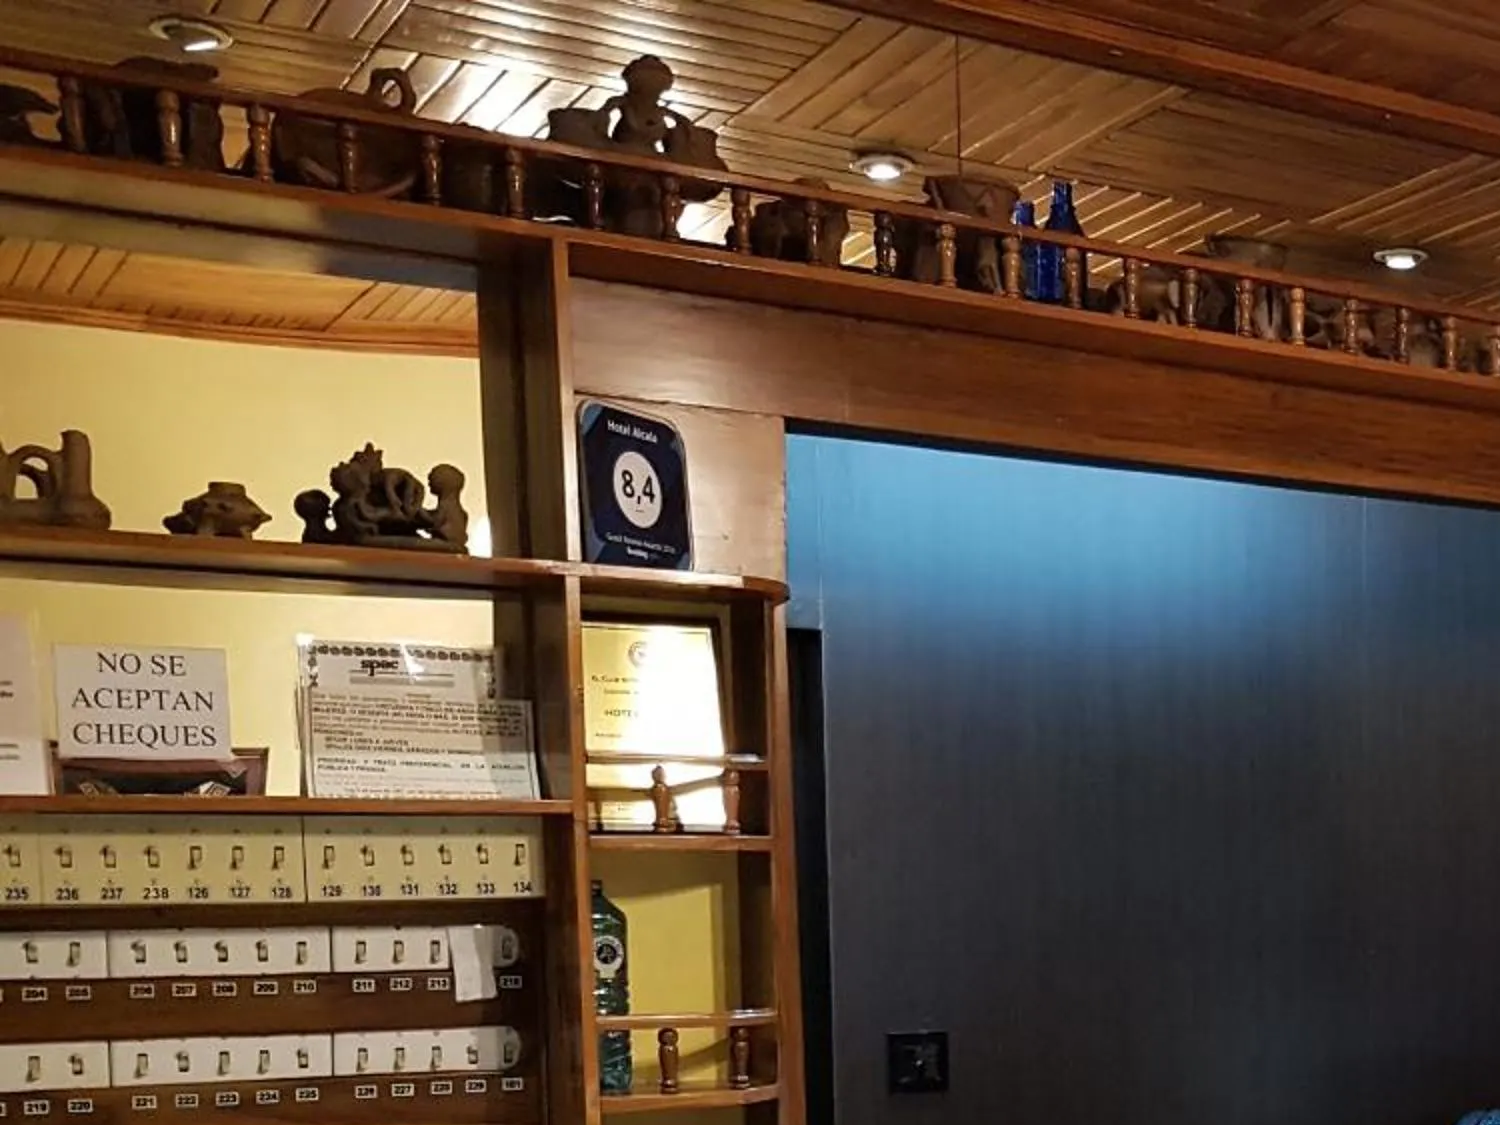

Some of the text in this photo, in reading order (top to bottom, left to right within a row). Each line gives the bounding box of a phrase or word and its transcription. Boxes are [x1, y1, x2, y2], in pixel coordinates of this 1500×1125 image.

[607, 419, 631, 437] Hotel
[621, 469, 656, 504] 8,4
[97, 651, 187, 676] NO SE
[71, 687, 215, 711] ACEPTAN
[72, 722, 218, 749] CHEQUES
[4, 887, 29, 900] 235
[55, 887, 79, 900] 236
[100, 887, 123, 899] 237
[142, 888, 169, 899] 238
[187, 887, 209, 899] 126
[270, 887, 292, 899] 128
[400, 884, 419, 895] 131
[438, 883, 458, 895] 132
[475, 883, 496, 894] 133
[512, 882, 533, 892] 134
